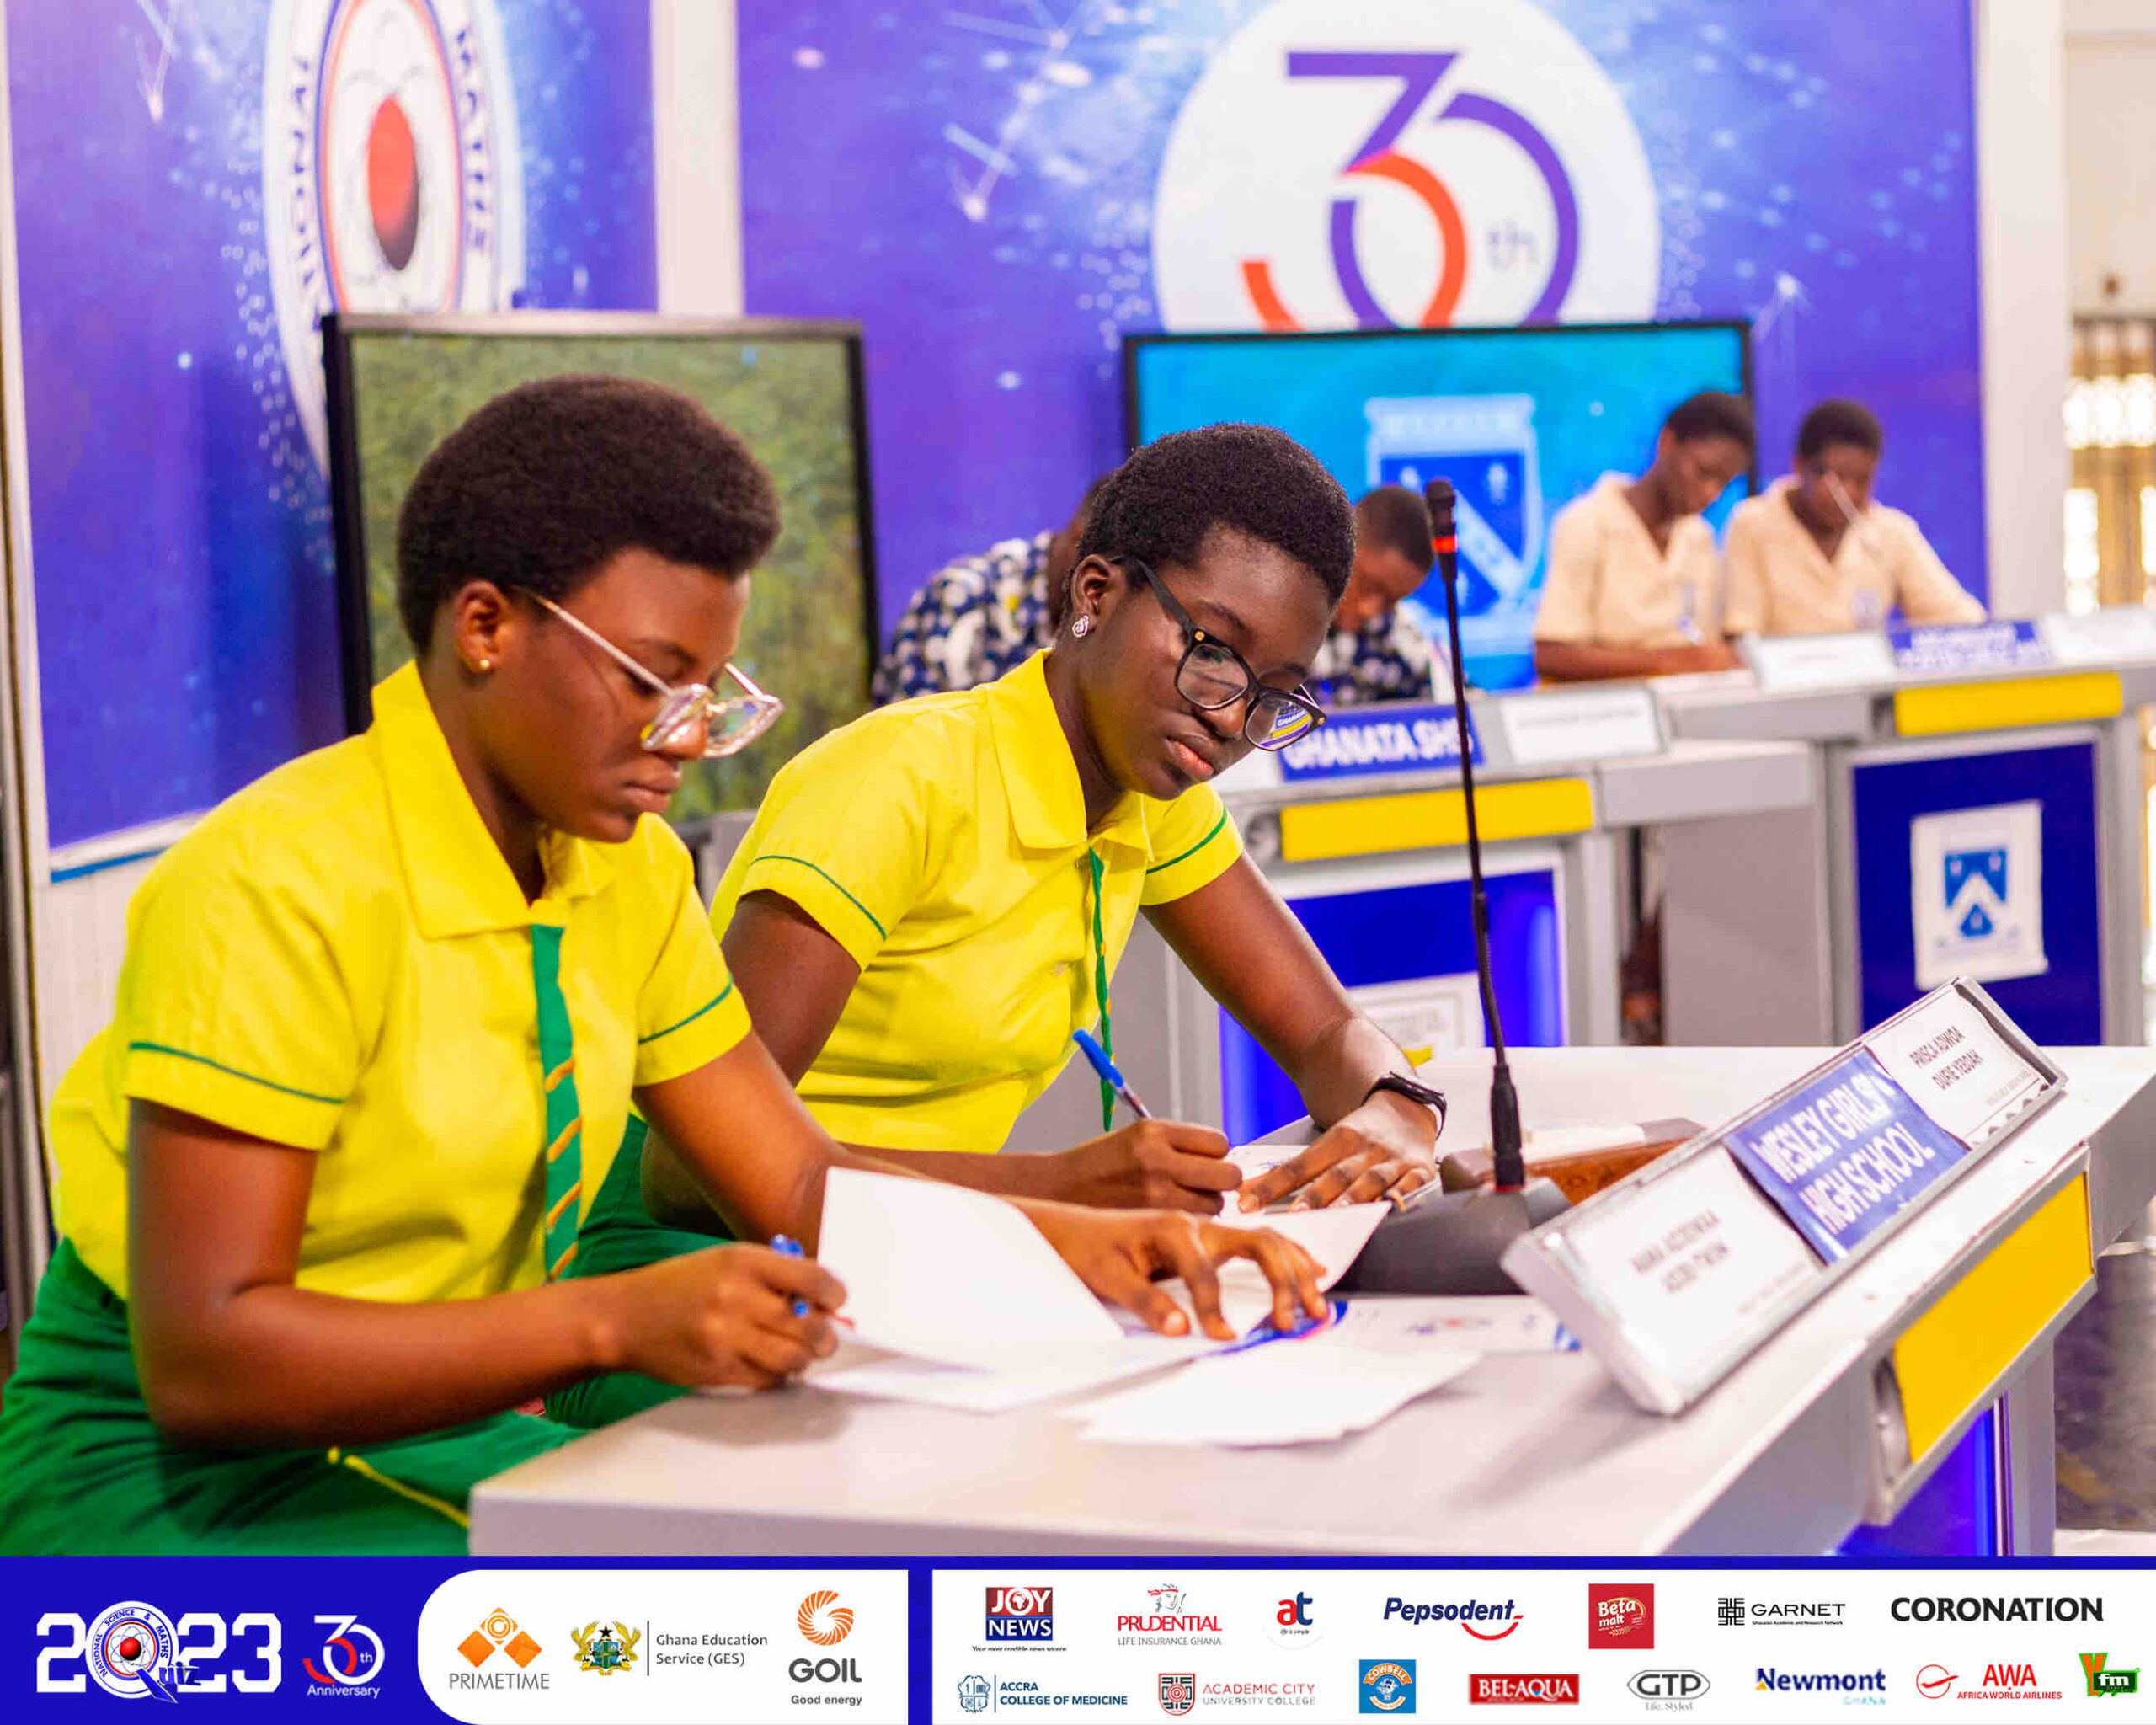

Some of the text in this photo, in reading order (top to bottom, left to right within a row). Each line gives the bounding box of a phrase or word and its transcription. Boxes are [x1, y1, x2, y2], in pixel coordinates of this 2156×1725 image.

[1749, 1105, 1842, 1183] WESLEY
[1799, 1122, 1935, 1226] HIGH SCHOOL
